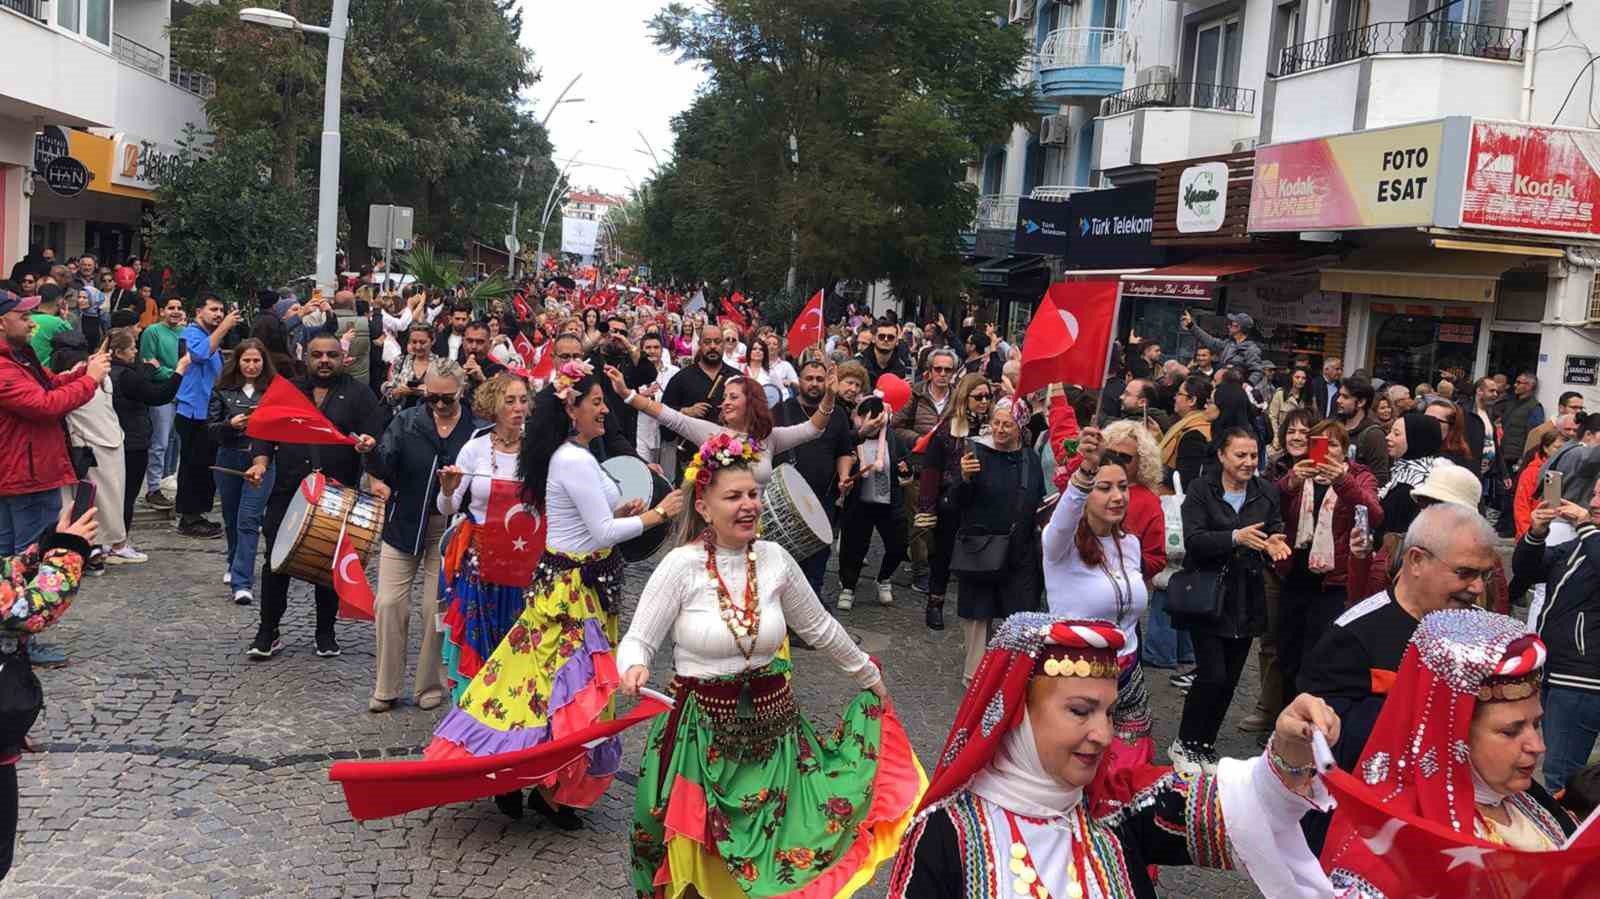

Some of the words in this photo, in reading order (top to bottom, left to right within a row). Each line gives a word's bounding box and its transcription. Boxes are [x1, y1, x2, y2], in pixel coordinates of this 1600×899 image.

[1382, 147, 1428, 172] FOTO
[51, 169, 83, 185] HAN
[1279, 175, 1314, 198] Kodak
[1514, 173, 1575, 199] Kodak
[1376, 177, 1428, 203] ESAT
[1091, 217, 1110, 236] Türk
[1113, 215, 1153, 234] Telekom
